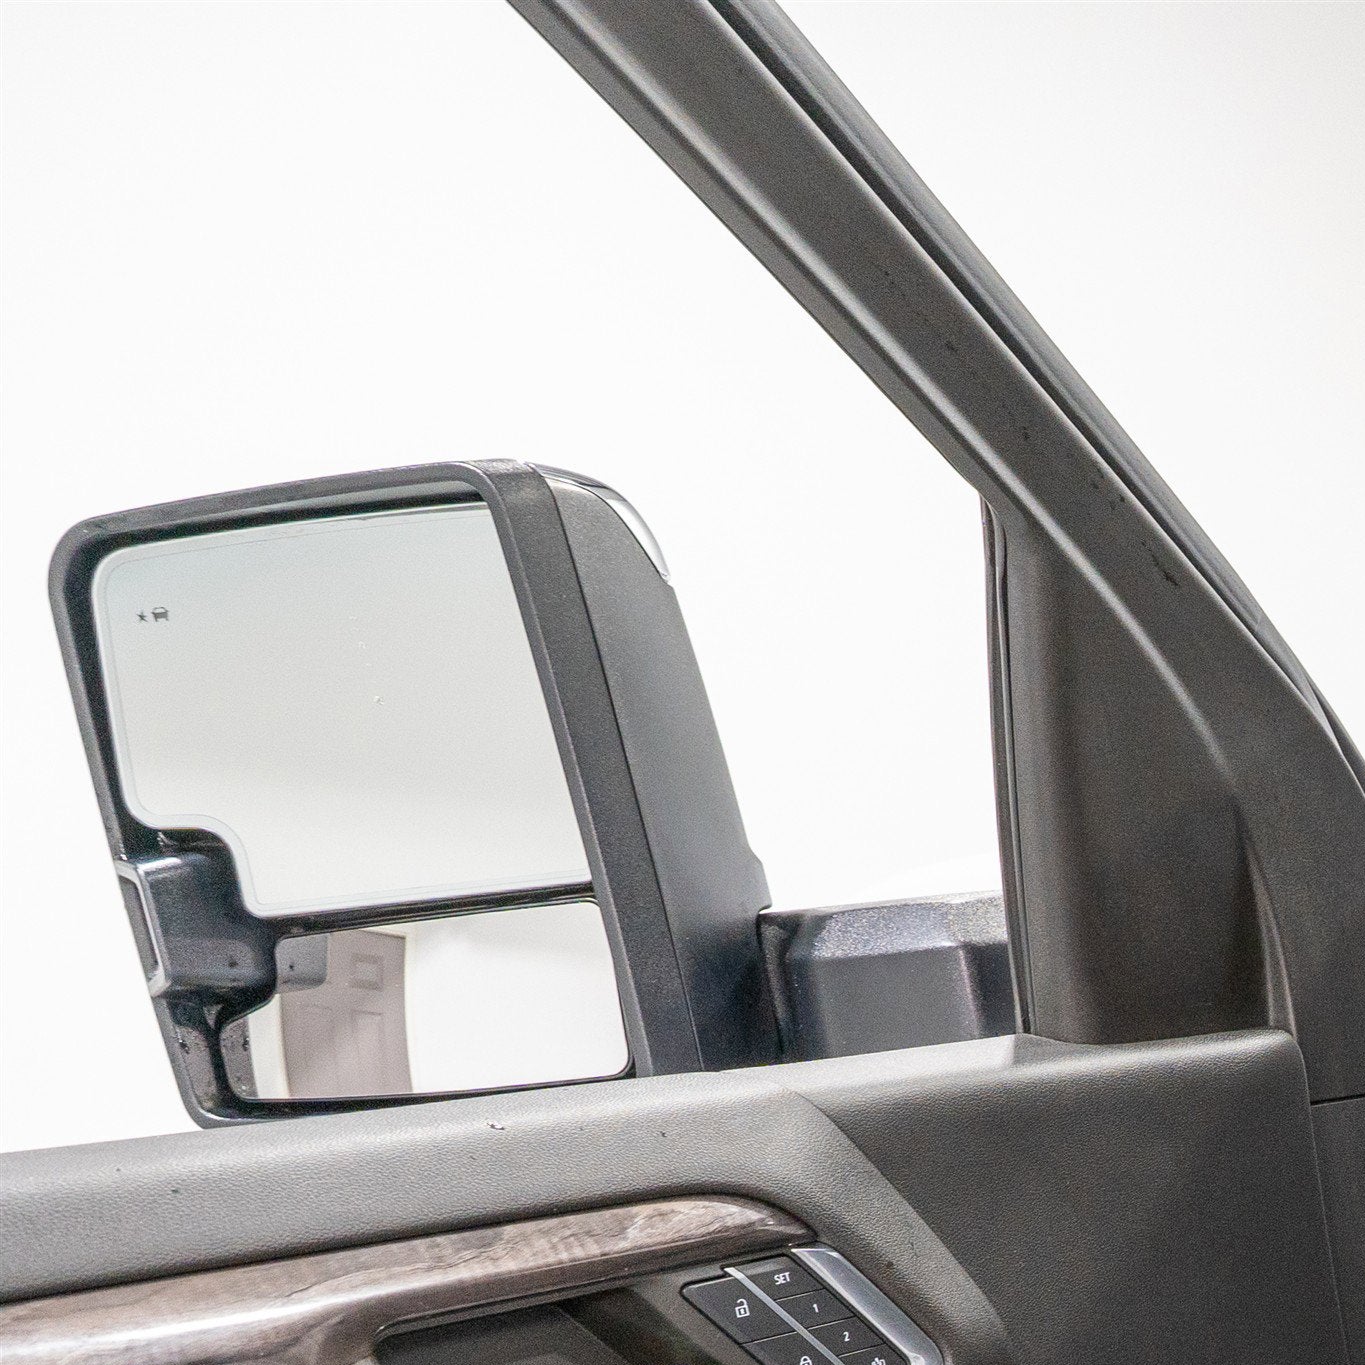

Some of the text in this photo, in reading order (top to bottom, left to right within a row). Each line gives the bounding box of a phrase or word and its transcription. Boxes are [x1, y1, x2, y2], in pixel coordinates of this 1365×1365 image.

[774, 1272, 790, 1285] SET
[812, 1303, 819, 1313] 1
[843, 1332, 850, 1342] 2
